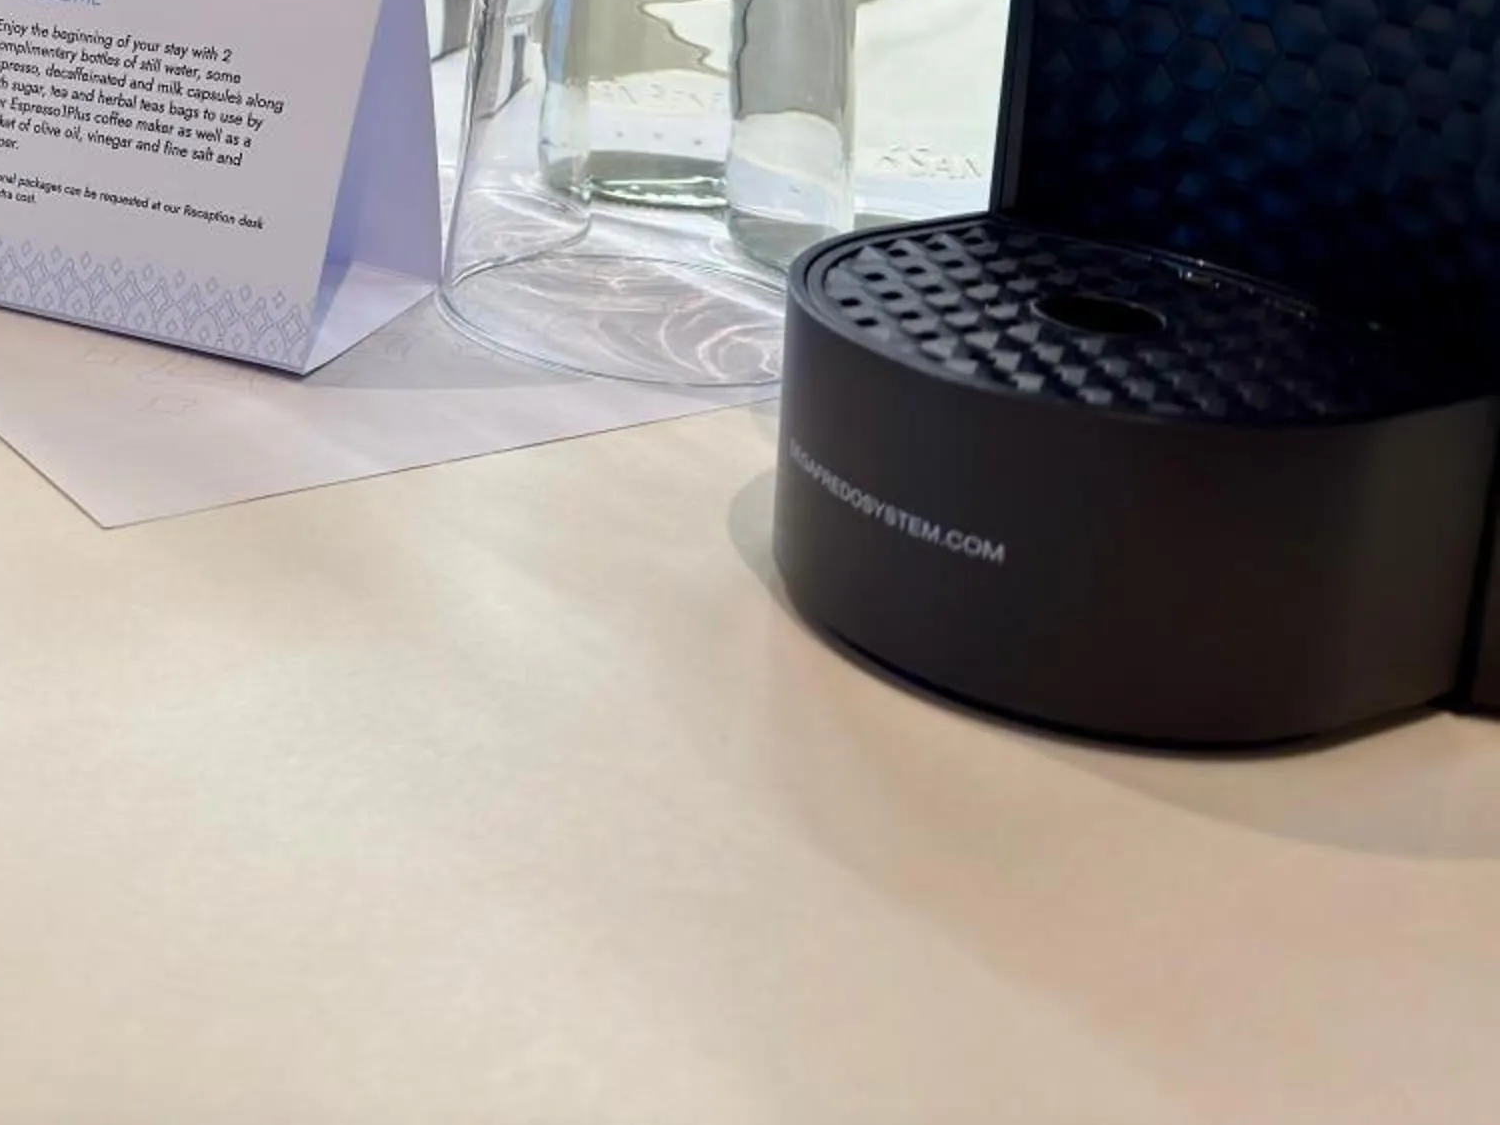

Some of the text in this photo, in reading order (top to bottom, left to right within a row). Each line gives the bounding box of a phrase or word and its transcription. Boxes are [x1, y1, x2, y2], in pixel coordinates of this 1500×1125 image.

[31, 23, 49, 38] the
[52, 26, 113, 49] beginning
[117, 34, 131, 48] of
[132, 39, 160, 53] your
[164, 43, 189, 59] stay
[191, 46, 218, 61] with
[221, 48, 232, 63] 2
[80, 49, 120, 67] bottles
[123, 55, 138, 69] of
[140, 58, 161, 72] still
[165, 64, 201, 81] water,
[205, 70, 241, 83] some
[12, 81, 45, 98] sugar,
[51, 85, 68, 98] tea
[71, 88, 95, 102] and
[98, 91, 137, 108] herbal
[140, 98, 165, 113] teas
[169, 101, 199, 121] bags
[203, 108, 216, 121] to
[220, 114, 242, 125] use
[247, 112, 264, 131] by
[45, 63, 127, 88] decaffeinated
[130, 77, 154, 91] and
[157, 81, 183, 97] milk
[187, 88, 242, 105] capsules
[246, 93, 285, 114] along
[18, 118, 32, 132] of
[33, 122, 60, 137] olive
[64, 127, 82, 142] oil,
[87, 130, 131, 149] vinegar
[136, 139, 160, 153] and
[164, 140, 188, 157] fine
[192, 147, 214, 161] salt
[216, 152, 242, 166] and
[93, 110, 133, 128] coffee
[136, 119, 174, 135] maker
[177, 127, 192, 138] as
[195, 127, 223, 142] well
[225, 134, 239, 146] as
[243, 138, 252, 148] a
